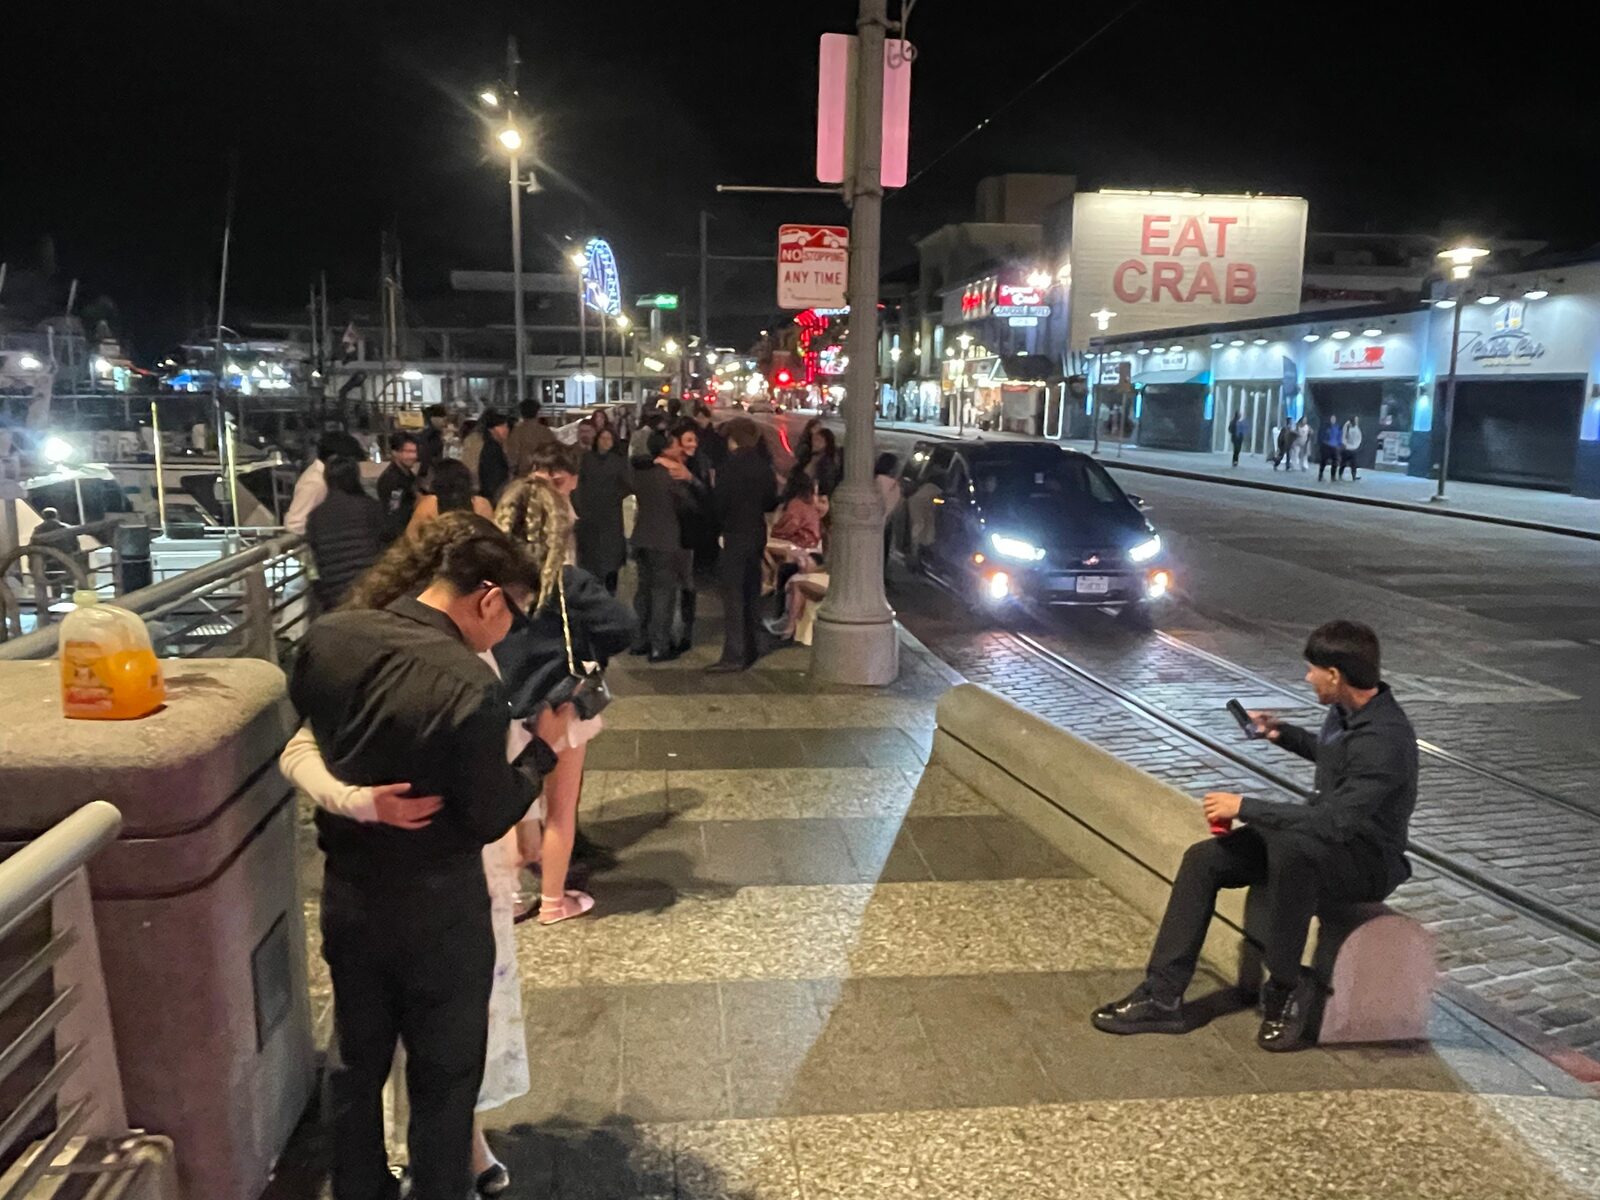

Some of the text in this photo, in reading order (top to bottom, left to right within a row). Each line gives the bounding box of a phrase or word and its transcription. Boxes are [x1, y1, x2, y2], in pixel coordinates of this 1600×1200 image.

[1141, 214, 1238, 258] EAT
[782, 249, 801, 261] NO
[784, 270, 842, 285] ANY TIME
[1113, 258, 1257, 305] CRAB
